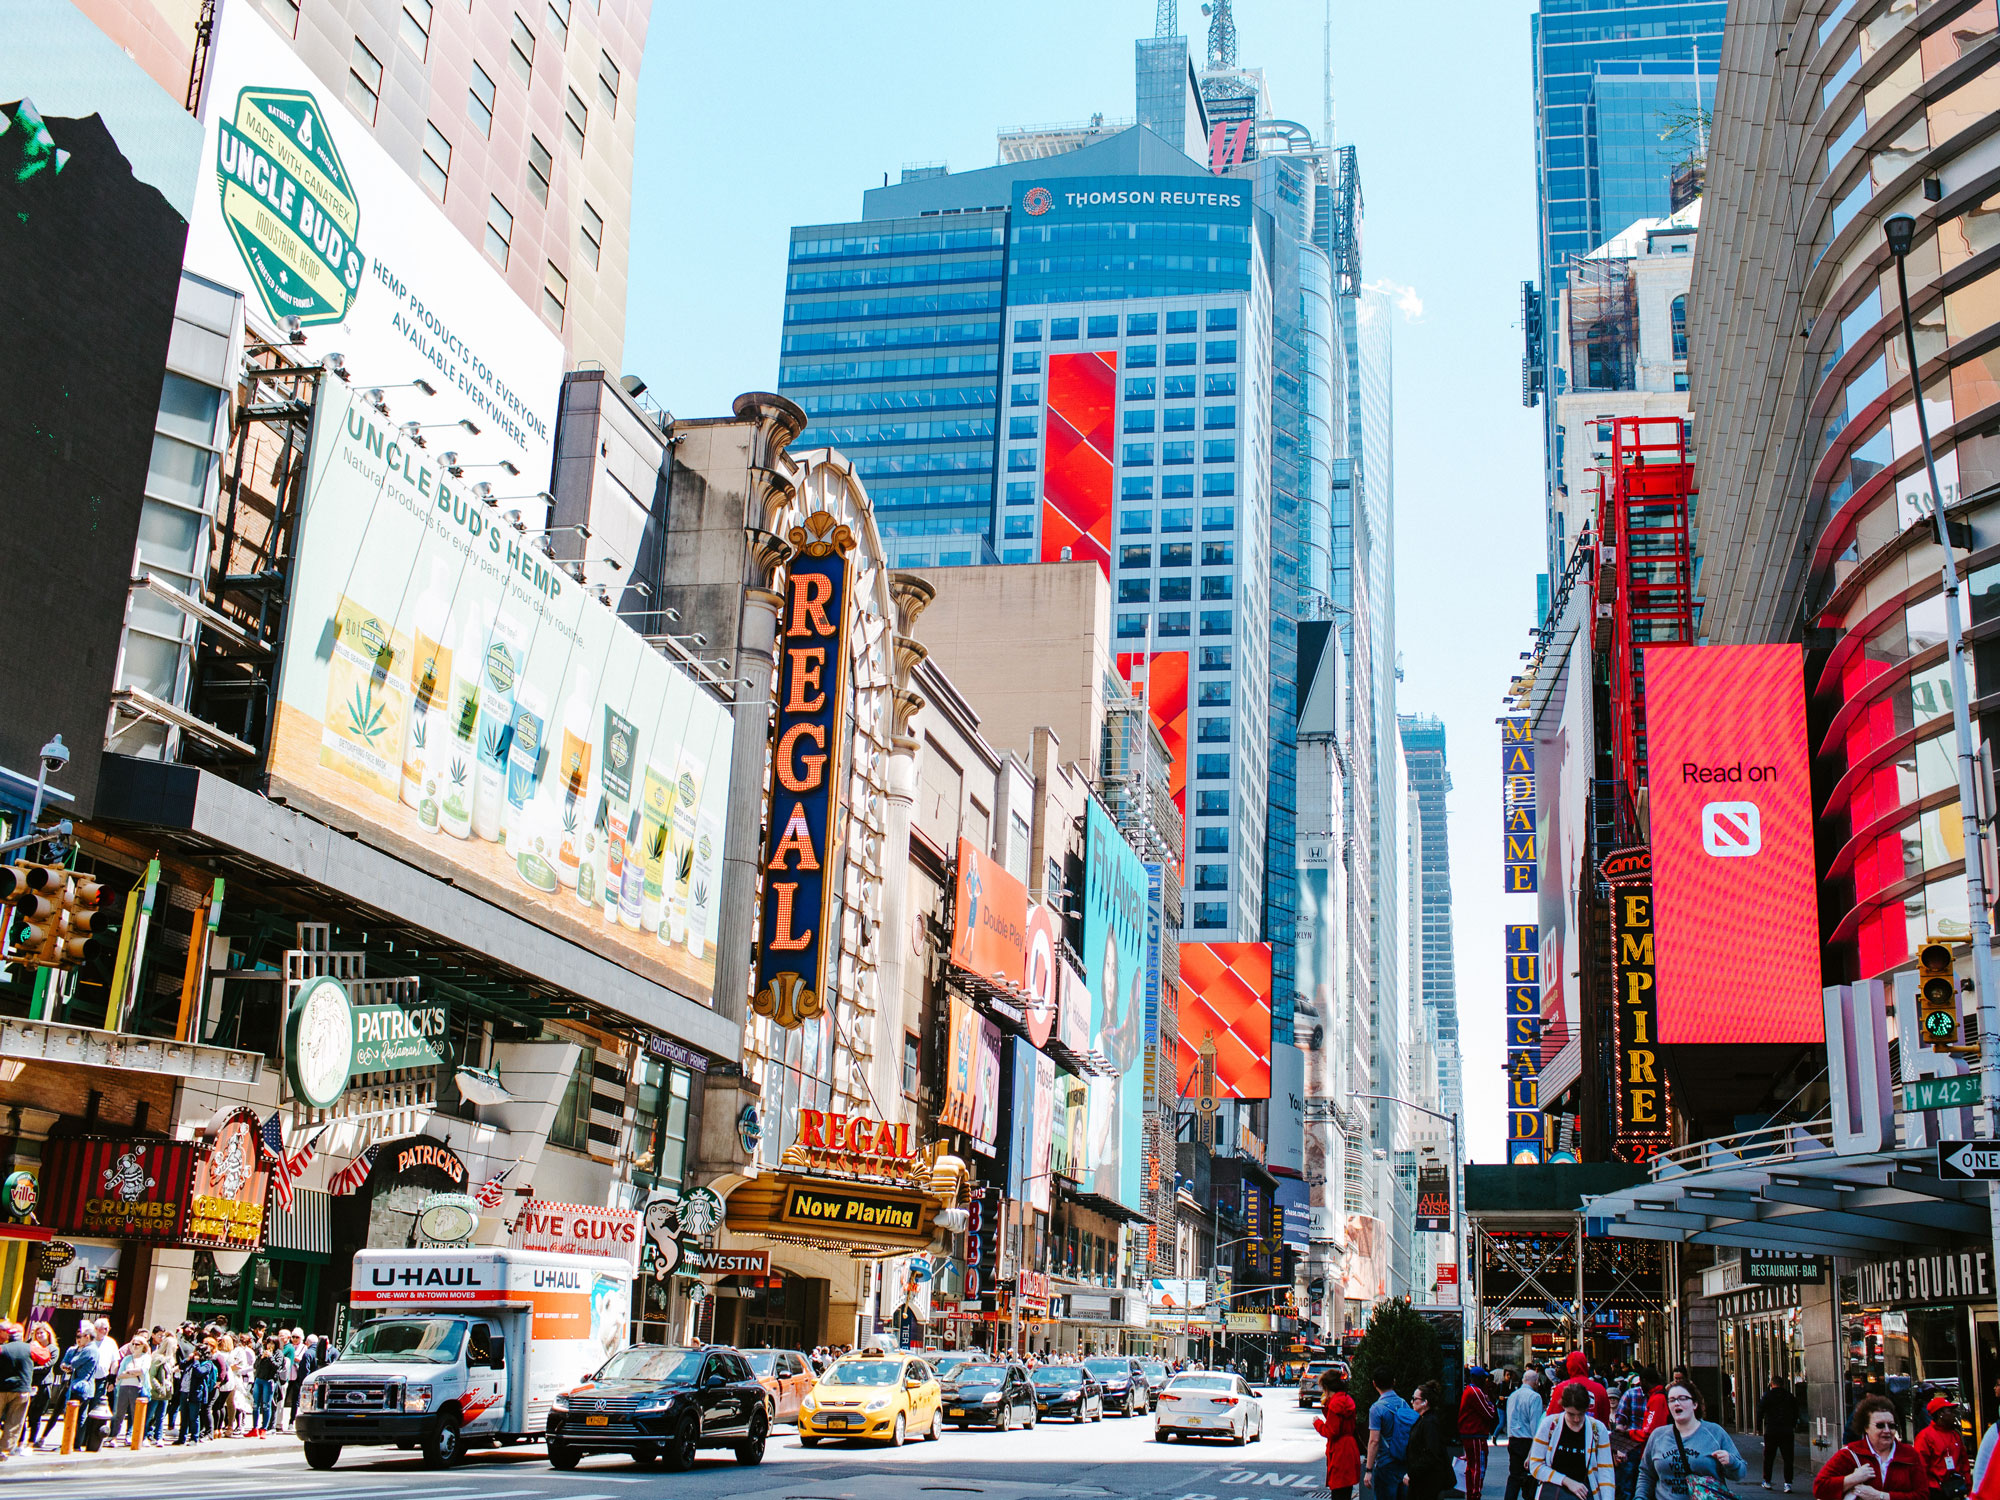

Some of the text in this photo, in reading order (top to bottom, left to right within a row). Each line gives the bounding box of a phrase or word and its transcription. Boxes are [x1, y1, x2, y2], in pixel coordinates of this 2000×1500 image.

[267, 104, 295, 129] NATURE'S
[245, 112, 275, 149] MADE
[277, 139, 302, 173] WITH
[316, 146, 339, 182] ORIGINAL
[219, 129, 361, 289] UNCLE BUD'S
[1065, 191, 1241, 207] THOMSON REUTERS
[255, 210, 321, 282] INDUSTRIAL HEMP
[255, 253, 275, 288] TRUSTED
[274, 282, 293, 306] FAMILY
[373, 257, 549, 445] HEMP PRODUCTS FOR EVERYONE,
[392, 312, 528, 452] AVAILABLE EVERYWHERE.
[347, 407, 562, 601] UNCLE BUD'S HEMP
[343, 446, 586, 650] Natural products for every part of your daily routine.
[768, 573, 836, 951] REGAL
[1682, 762, 1777, 784] Read on
[1506, 718, 1537, 891] MADAME
[1092, 825, 1146, 938] Fly Away
[983, 905, 1024, 952] Double Play
[1621, 895, 1657, 1122] EMPIRE
[357, 1007, 446, 1044] PATRICK'S
[1511, 926, 1539, 1138] TUSSAUD
[380, 1040, 424, 1070] Restaurant
[652, 1036, 708, 1073] OUTFRONT PRIME
[1037, 1060, 1053, 1090] Rosé
[1203, 1058, 1211, 1093] THEATRE
[1920, 1079, 1979, 1107] W 42 ST
[798, 1108, 917, 1160] REGAL
[1202, 1119, 1210, 1144] LYRIC
[398, 1144, 463, 1183] PATRICK'S
[809, 1152, 905, 1178] CINEMAS
[1632, 1145, 1659, 1164] 25
[1962, 1152, 1999, 1169] ONE
[10, 1184, 36, 1204] villa
[85, 1198, 177, 1220] CRUMBS
[192, 1194, 264, 1225] CRUMBS
[1418, 1204, 1450, 1215] RISE
[1421, 1193, 1448, 1205] ALL
[134, 1218, 174, 1230] SHOP
[514, 1210, 636, 1243] FIVE GUYS
[795, 1195, 914, 1228] Now Playing
[1247, 1189, 1258, 1237] VICTORY
[700, 1253, 764, 1271] WESTIN
[965, 1201, 983, 1299] BBQ
[1272, 1256, 1282, 1278] NEW
[1864, 1260, 1901, 1303] TIMES
[1907, 1252, 1989, 1301] SQUARE
[376, 1291, 476, 1299] ONE-WAY & IN-TOWN MOVES
[1237, 1304, 1298, 1317] HARRY POTTER
[1719, 1284, 1798, 1317] DOWNSTAIRS
[962, 1312, 980, 1321] BBQ
[1230, 1314, 1258, 1324] POTTER
[902, 1325, 910, 1345] TIER
